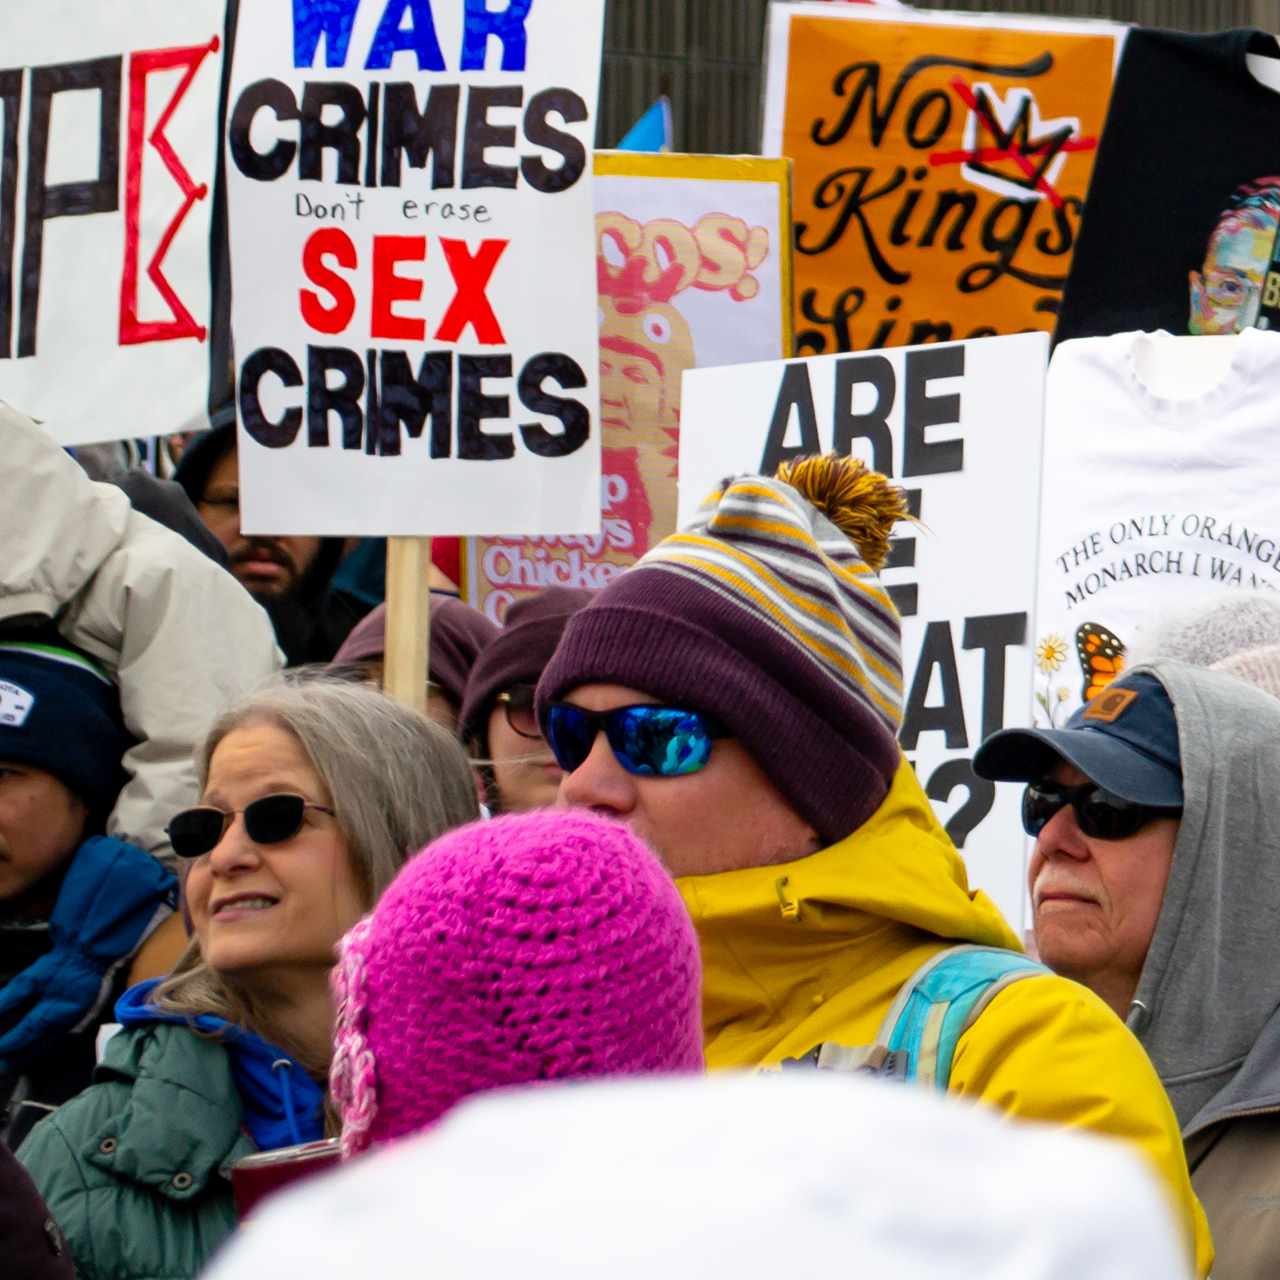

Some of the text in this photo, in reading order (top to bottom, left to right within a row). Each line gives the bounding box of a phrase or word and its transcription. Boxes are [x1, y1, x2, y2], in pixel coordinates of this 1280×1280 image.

[229, 78, 588, 194] CRIMES
[296, 193, 492, 222] Don't erase
[794, 166, 1083, 293] Kings
[300, 228, 510, 344] SEX
[240, 346, 590, 460] CRIMES
[760, 344, 965, 479] ARE
[484, 546, 632, 589] Chicke
[1056, 532, 1103, 573] THE
[1109, 514, 1175, 545] ONLY
[1064, 550, 1183, 610] MONARCH
[1193, 553, 1201, 577] I
